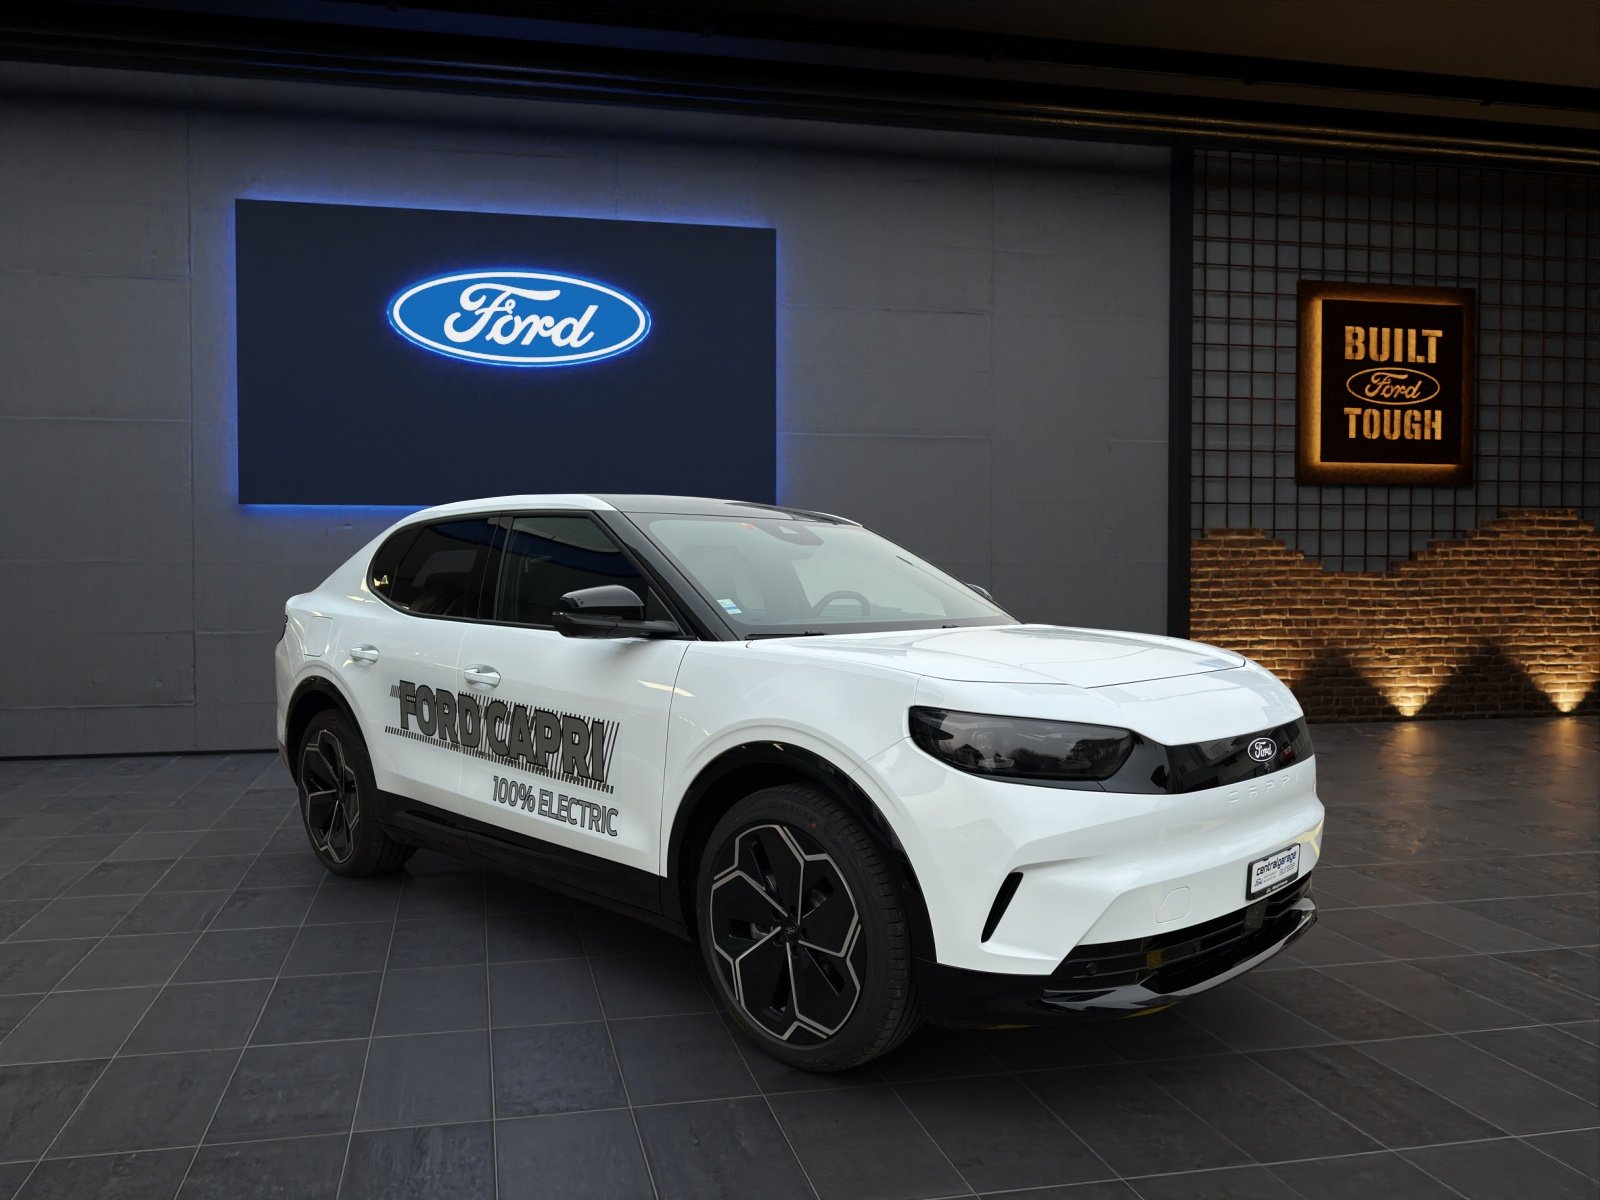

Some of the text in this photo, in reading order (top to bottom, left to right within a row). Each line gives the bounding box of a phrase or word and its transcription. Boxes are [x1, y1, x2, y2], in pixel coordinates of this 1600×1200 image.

[444, 283, 598, 347] Ford
[1345, 326, 1443, 363] BUILT
[1365, 372, 1422, 398] Ford
[1344, 407, 1442, 440] TOUGH
[400, 680, 605, 783] FORD CAPRI
[1254, 741, 1273, 759] Ford
[493, 775, 619, 837] 100% ELECTRIC
